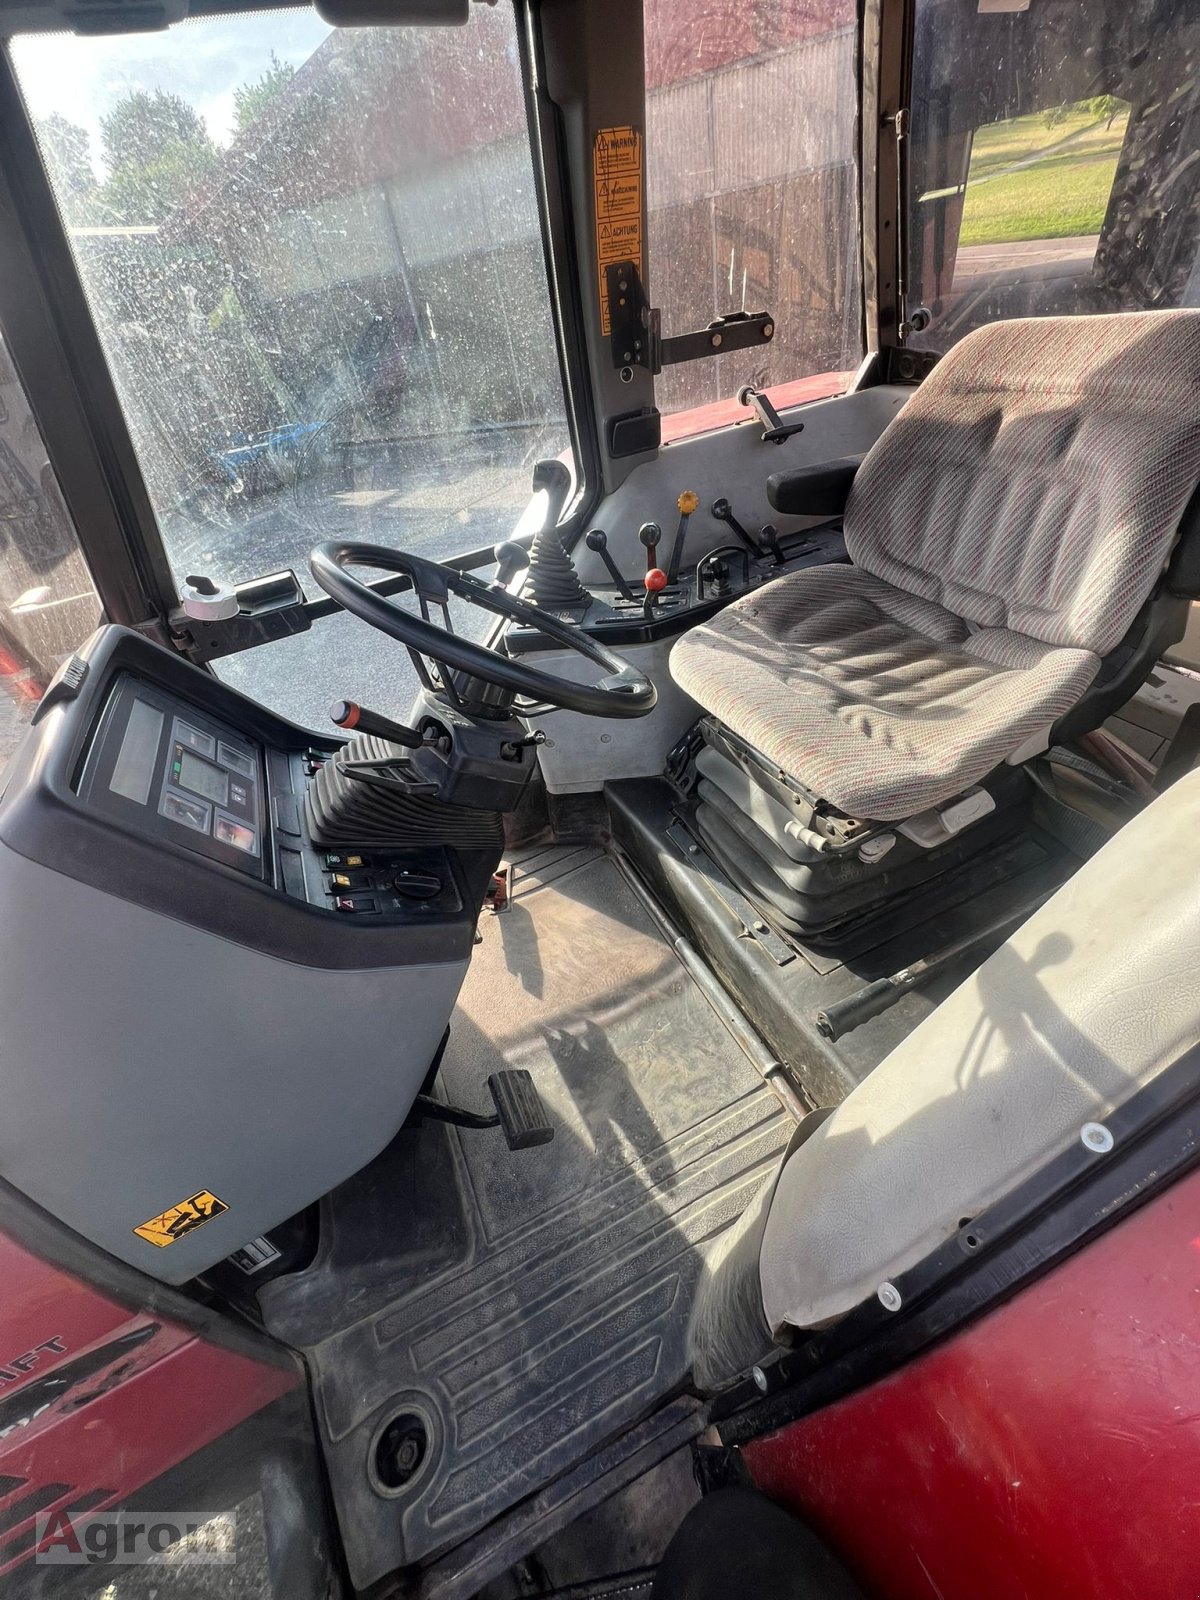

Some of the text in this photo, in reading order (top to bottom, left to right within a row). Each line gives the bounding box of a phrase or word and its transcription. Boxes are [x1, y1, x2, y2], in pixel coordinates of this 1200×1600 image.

[610, 137, 637, 149] WARNING
[612, 225, 637, 236] ACHTUNG
[0, 1335, 68, 1388] IFT
